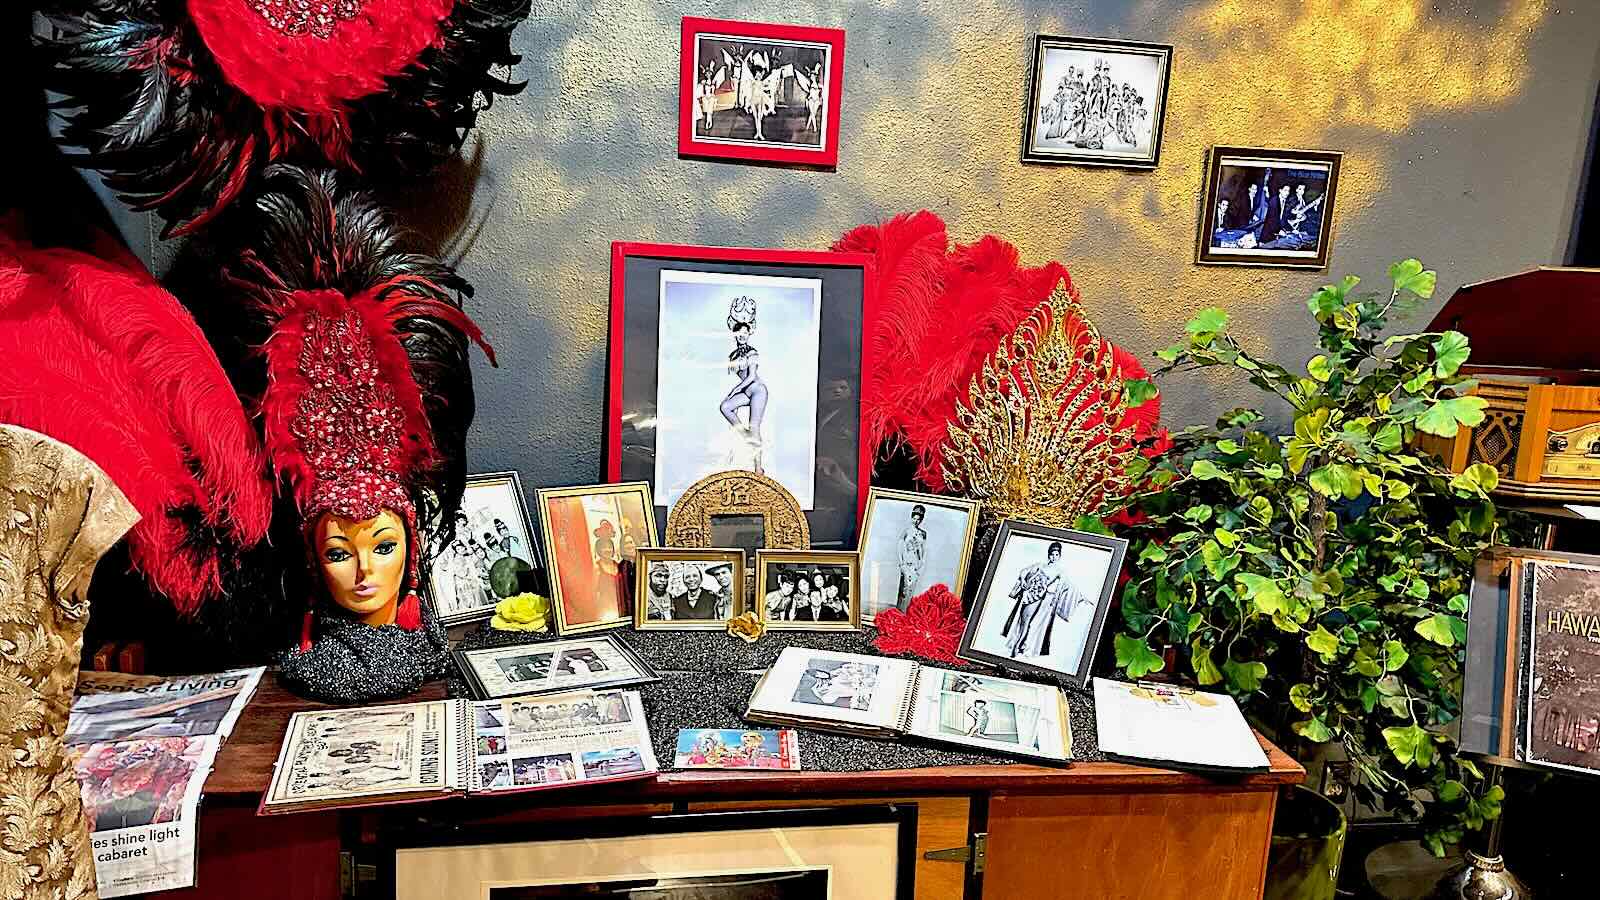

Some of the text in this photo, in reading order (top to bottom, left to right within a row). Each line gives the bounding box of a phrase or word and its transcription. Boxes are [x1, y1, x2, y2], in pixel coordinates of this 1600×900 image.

[1548, 611, 1600, 637] HAWA
[79, 677, 238, 694] Senior Living
[420, 757, 439, 784] COMING
[111, 833, 146, 847] shine
[149, 827, 180, 843] light
[97, 846, 148, 862] cabaret
